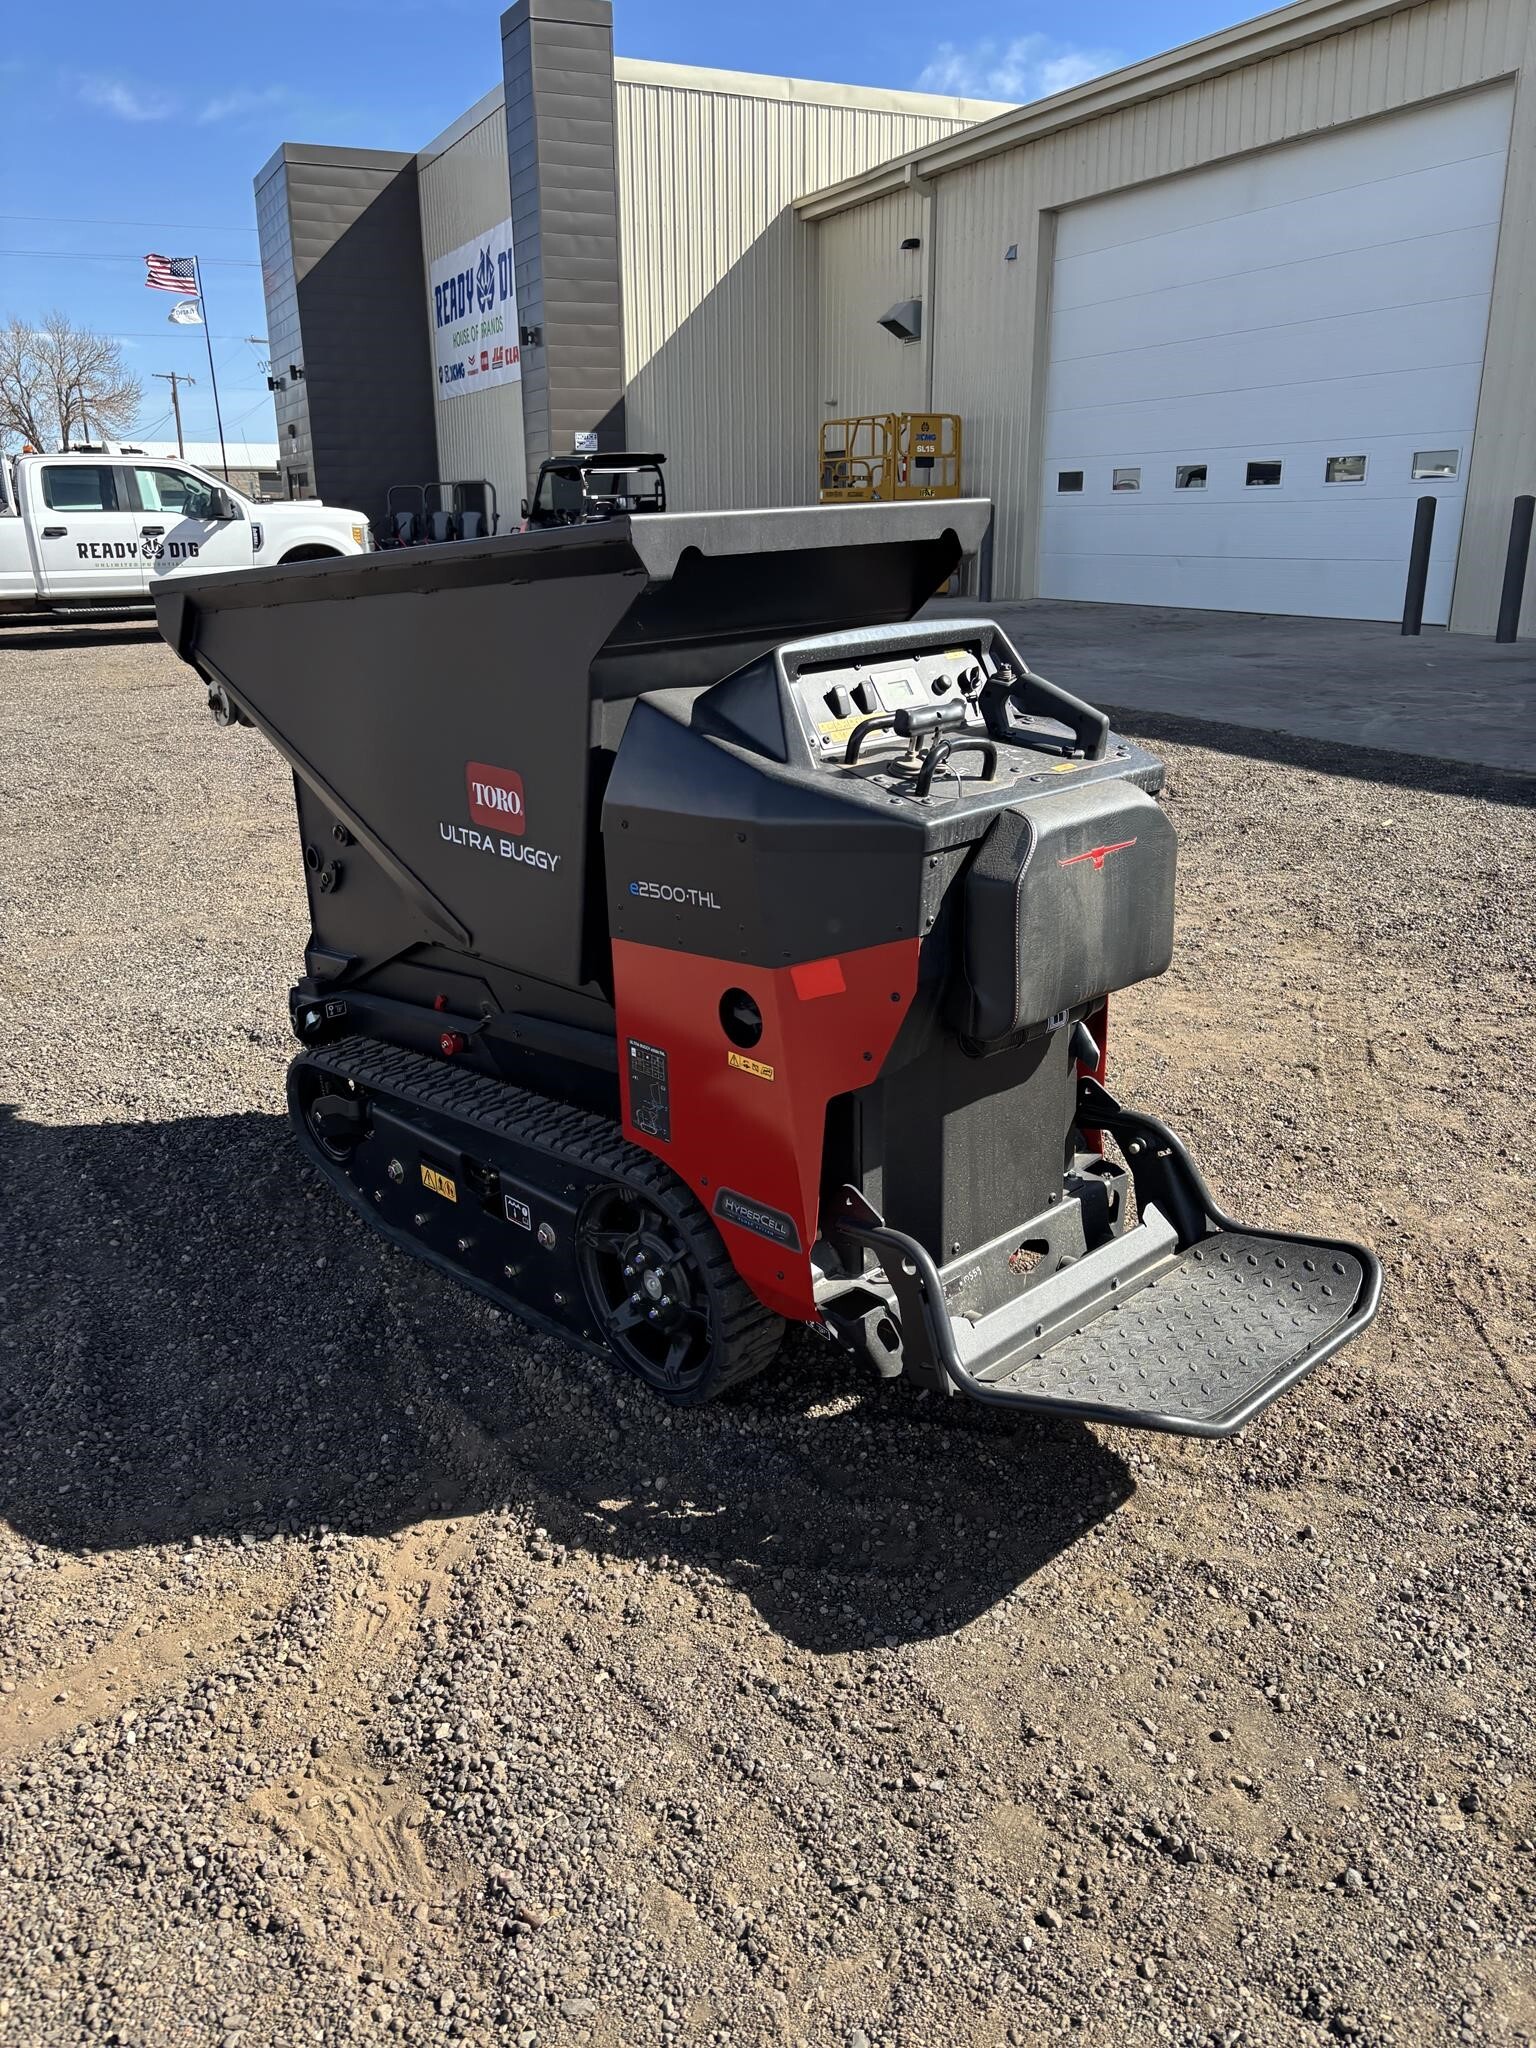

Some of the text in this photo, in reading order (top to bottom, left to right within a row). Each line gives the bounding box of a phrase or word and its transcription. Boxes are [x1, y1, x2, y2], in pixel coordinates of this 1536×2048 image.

[434, 267, 474, 328] READY
[452, 315, 504, 347] HOUSE OF BRANDS
[917, 445, 935, 453] SL15
[76, 543, 199, 558] READY DIG
[472, 782, 521, 815] TORO
[439, 822, 559, 872] ULTRA BUGGY
[725, 1199, 787, 1234] HYPERCELL
